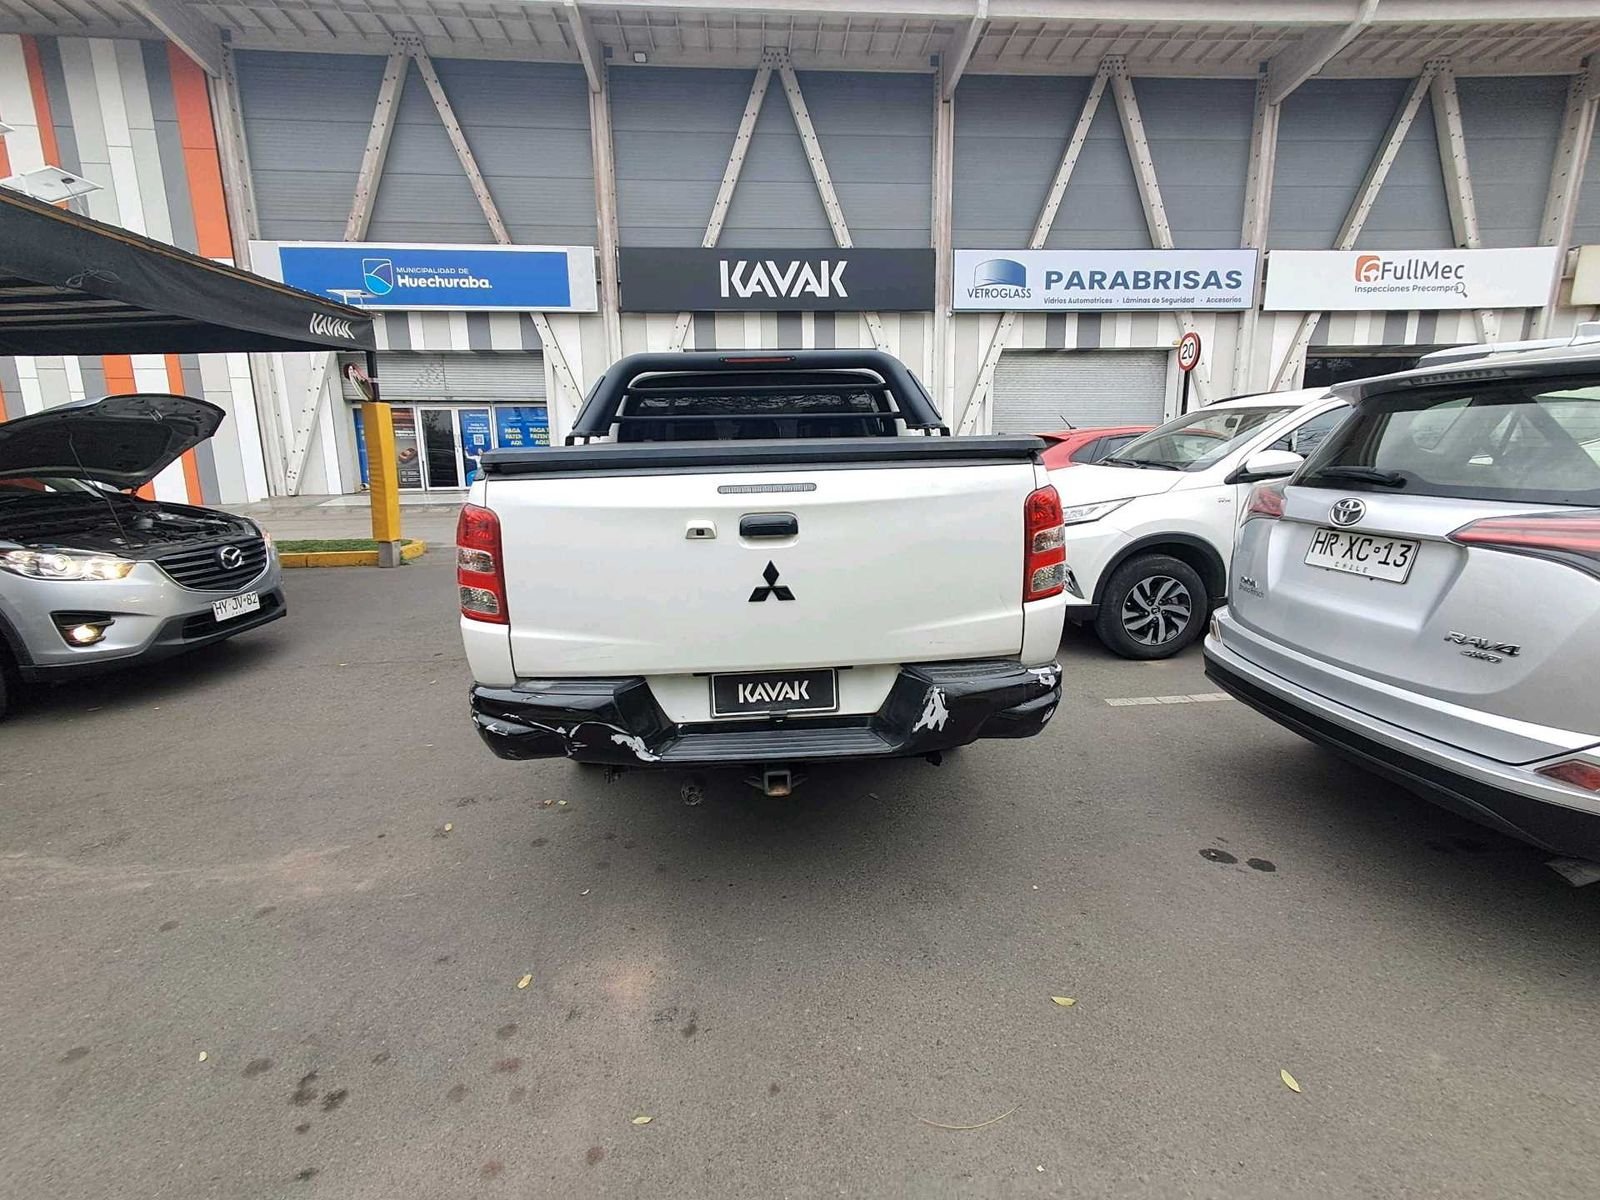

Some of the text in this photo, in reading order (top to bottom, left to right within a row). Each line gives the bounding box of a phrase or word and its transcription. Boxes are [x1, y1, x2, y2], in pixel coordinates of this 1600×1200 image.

[719, 260, 848, 298] KAVAK
[1381, 259, 1465, 280] FullMec
[397, 275, 493, 289] Huechuraba.
[1045, 270, 1242, 290] PARABRISAS
[1354, 284, 1459, 293] Inspecciones Precompra
[967, 288, 1032, 299] VETROGLASS
[1044, 297, 1066, 305] Vidrios
[1161, 296, 1195, 306] Seguridad
[309, 312, 356, 340] KAVAK
[1181, 342, 1195, 360] 20
[1444, 630, 1520, 657] RAV4
[738, 680, 810, 704] KAVAK
